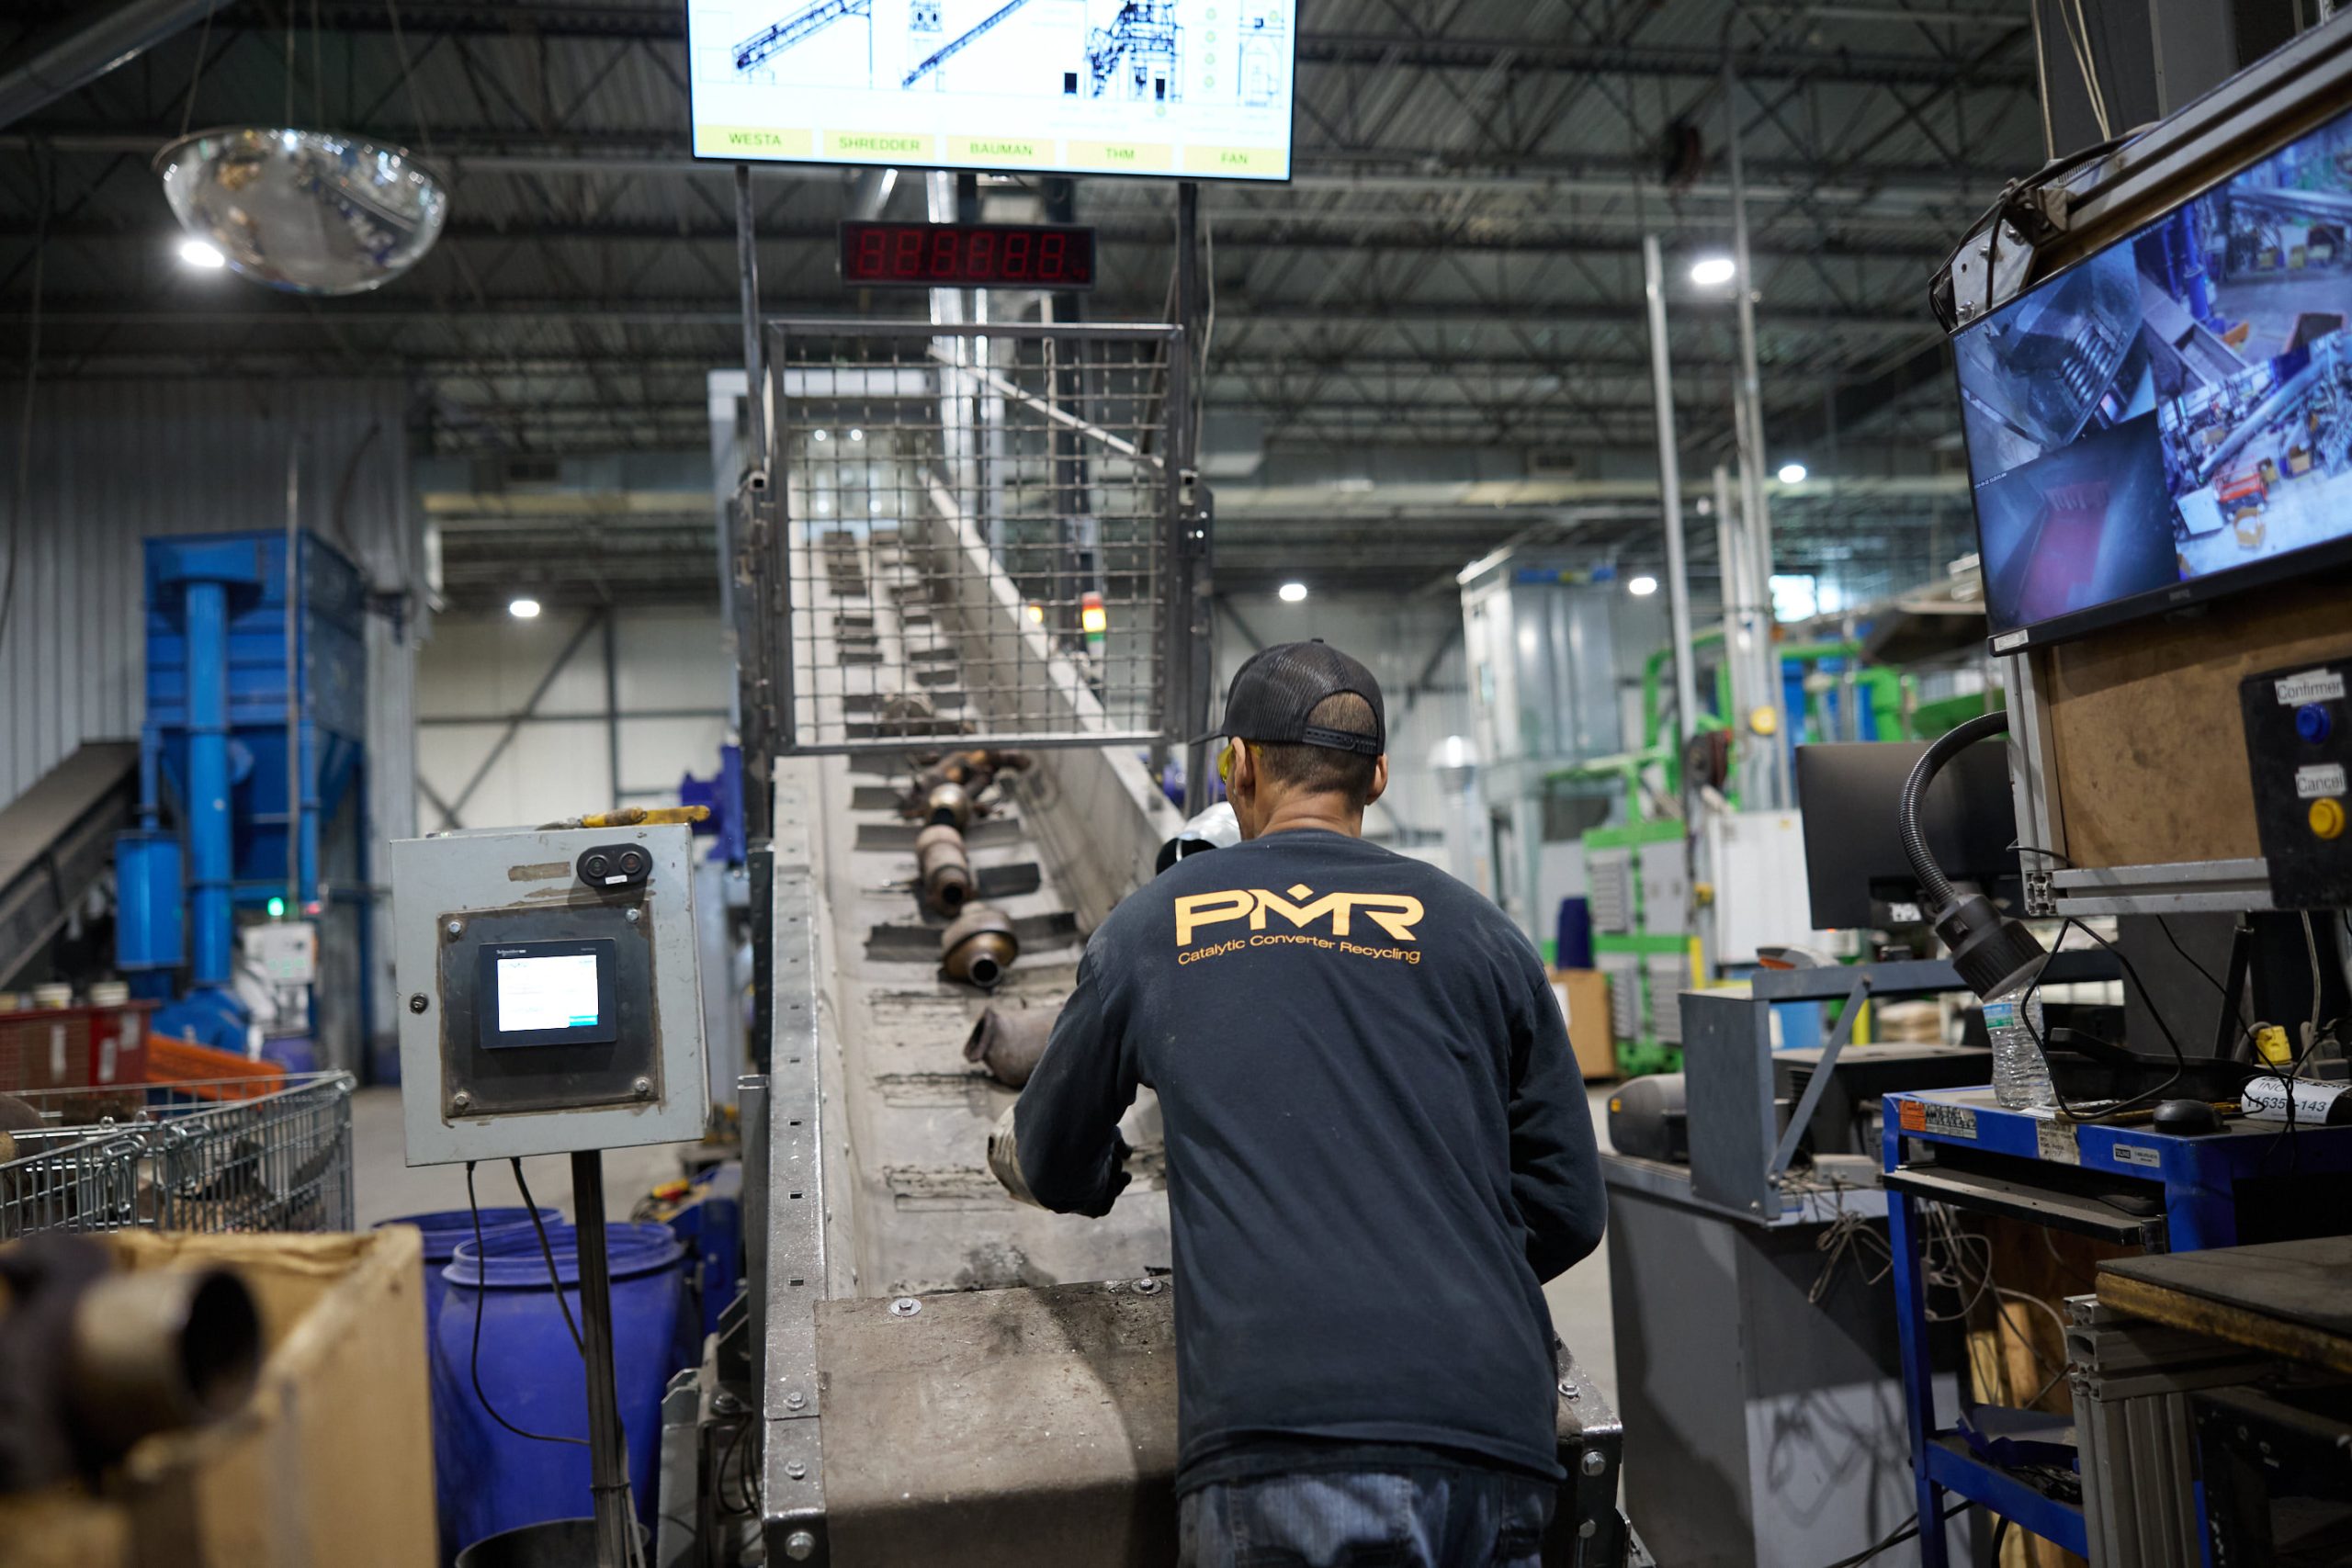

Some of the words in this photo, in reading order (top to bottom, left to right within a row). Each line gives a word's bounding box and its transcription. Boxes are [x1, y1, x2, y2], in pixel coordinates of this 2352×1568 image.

[729, 132, 782, 146] WESTA
[839, 136, 921, 152] SHREDDER
[969, 142, 1034, 157] BAUMAN
[1106, 147, 1136, 160] THM
[1220, 152, 1250, 165] FAN
[2299, 773, 2344, 793] Cancel
[1174, 884, 1425, 947] PMR
[1177, 939, 1247, 965] Catalytic
[1249, 933, 1336, 950] Converter
[1339, 941, 1422, 965] Recycling
